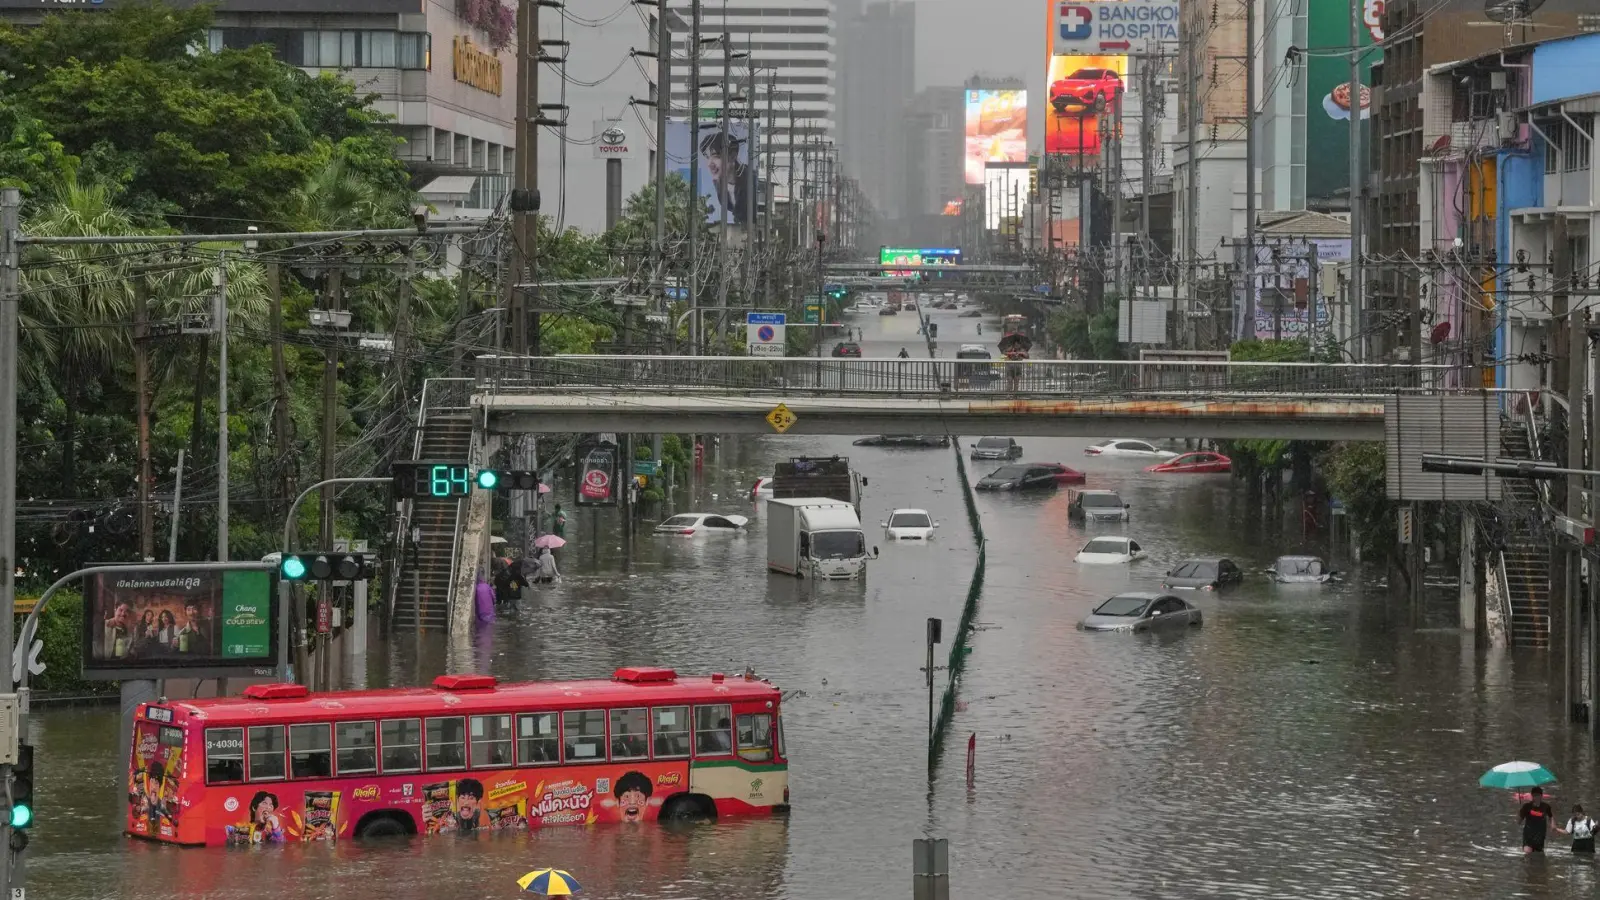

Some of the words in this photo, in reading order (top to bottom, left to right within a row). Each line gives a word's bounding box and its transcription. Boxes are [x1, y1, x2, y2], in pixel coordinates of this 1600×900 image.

[1099, 23, 1178, 39] HOSPITA
[774, 413, 782, 424] 5
[432, 466, 468, 496] 64
[235, 604, 257, 613] Chang
[207, 739, 243, 749] 3-40304
[15, 888, 22, 898] 3
